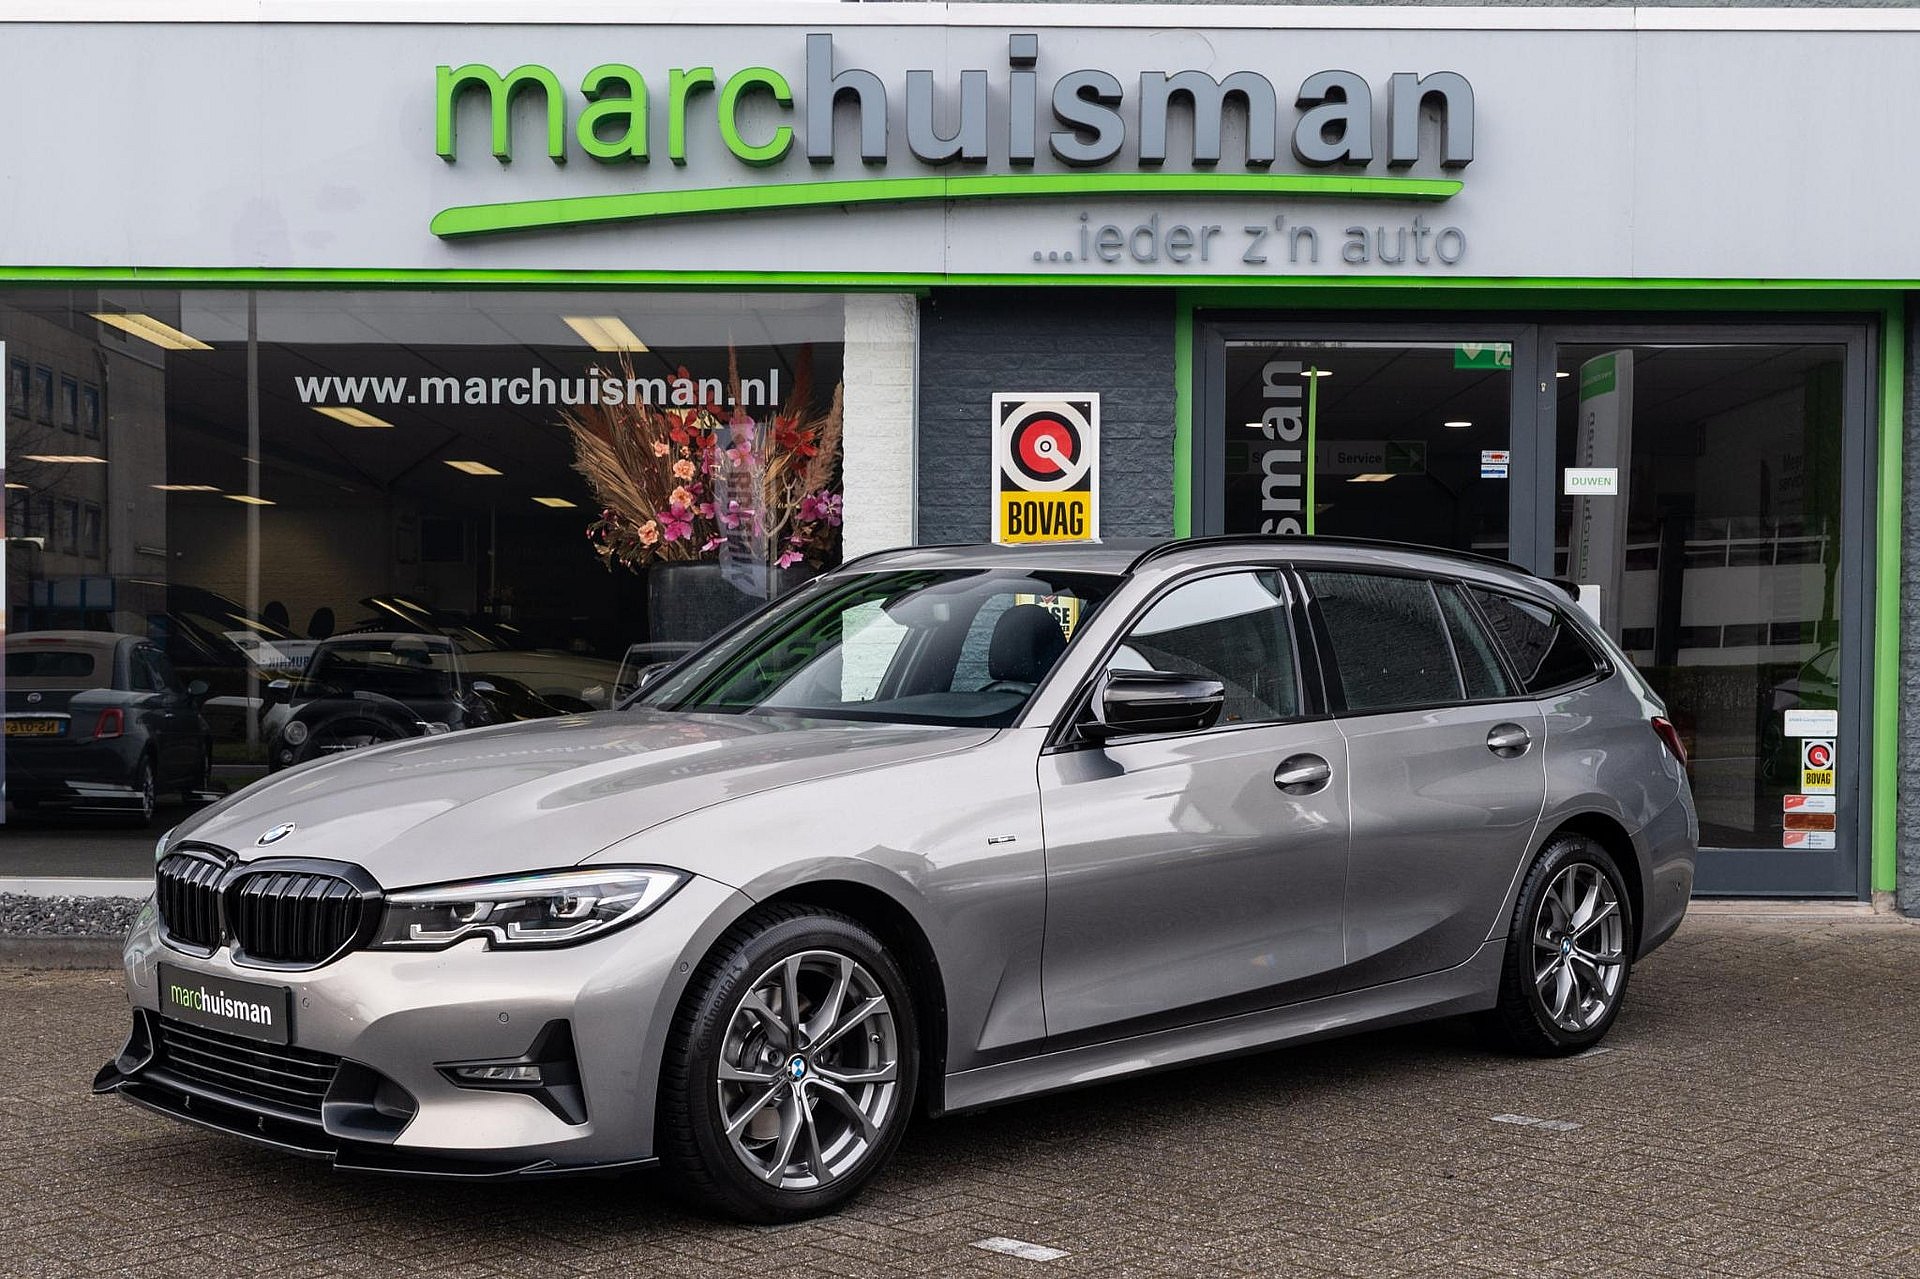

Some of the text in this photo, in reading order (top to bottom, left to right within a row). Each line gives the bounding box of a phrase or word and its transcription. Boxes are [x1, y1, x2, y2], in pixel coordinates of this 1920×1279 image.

[435, 33, 1475, 168] marchuisman
[1243, 214, 1319, 264] z'n
[1342, 215, 1467, 265] auto
[294, 367, 779, 406] www.marchuisman.nl
[1337, 451, 1383, 464] Service
[1571, 477, 1612, 486] DUWEN
[1008, 500, 1084, 536] BOVAG
[1806, 772, 1831, 785] BOVAG
[170, 985, 272, 1026] marchuisman
